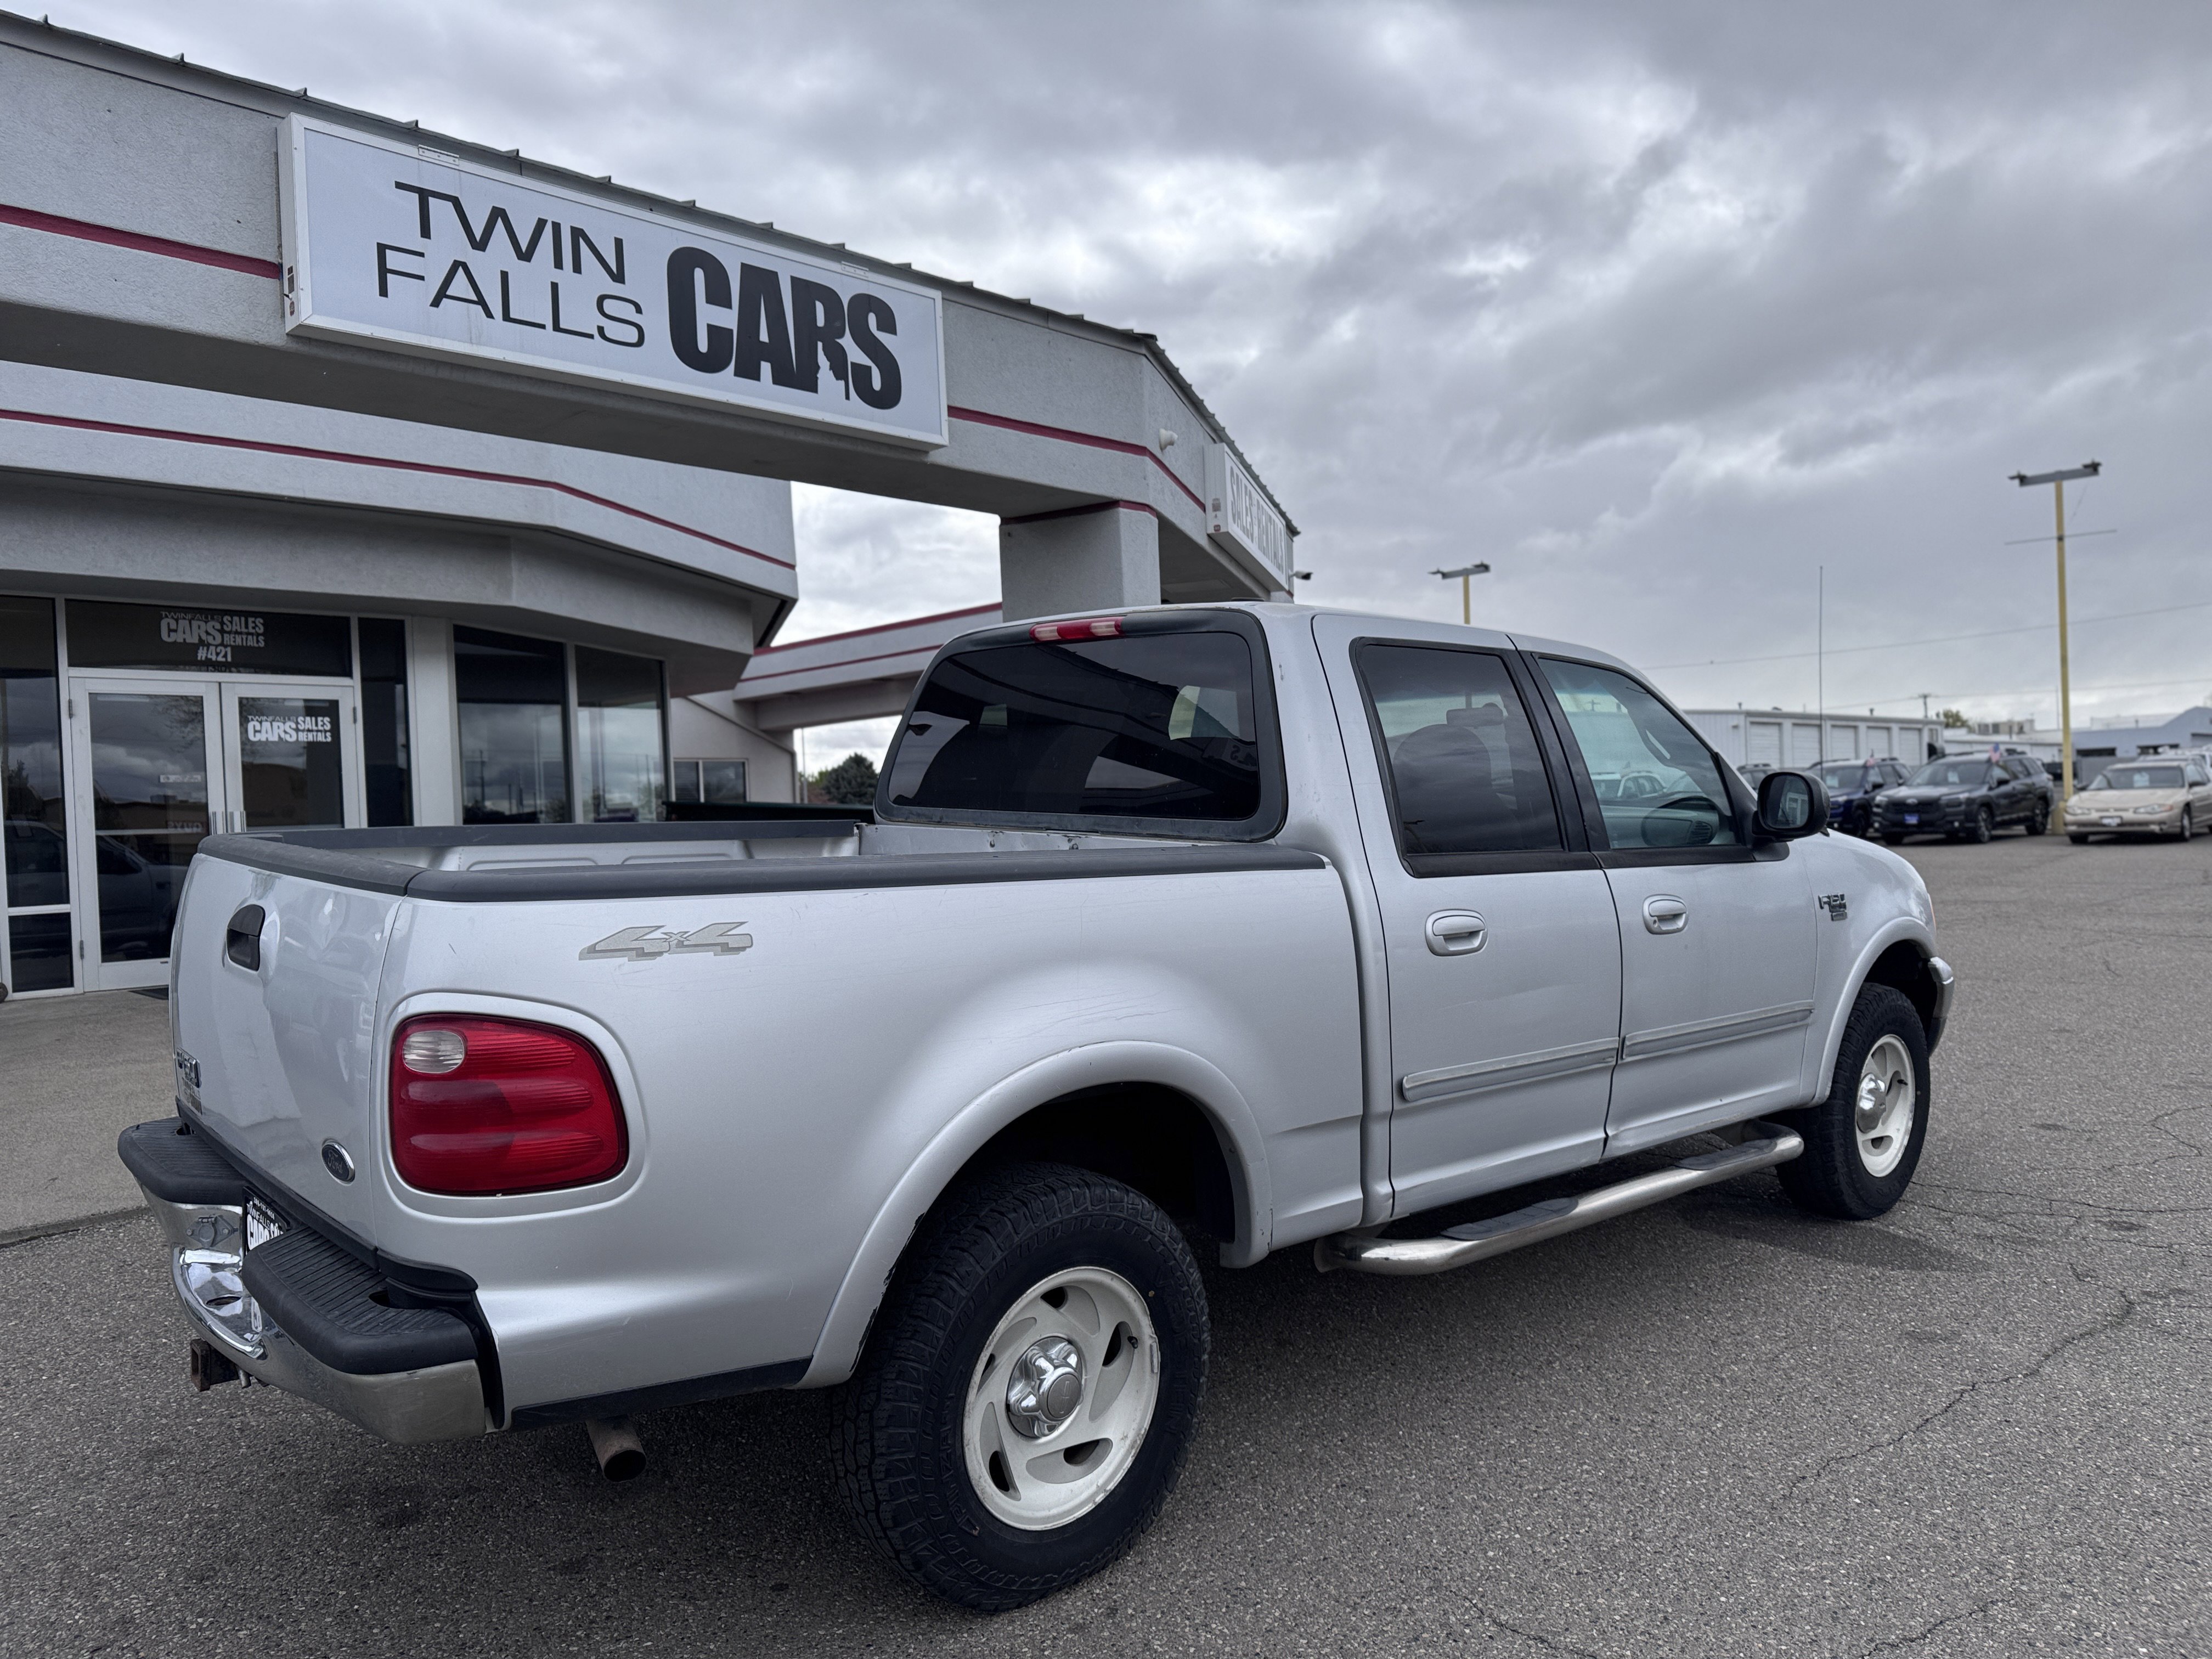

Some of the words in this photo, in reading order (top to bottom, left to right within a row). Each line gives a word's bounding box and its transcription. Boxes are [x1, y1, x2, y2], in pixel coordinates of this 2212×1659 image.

[394, 181, 625, 285] TWIN
[377, 242, 645, 348] FALLS
[667, 246, 902, 410] CARS
[1230, 466, 1254, 544] SALES
[1256, 499, 1284, 575] RENTALS
[160, 618, 222, 645] CARS
[223, 615, 264, 634] SALES
[224, 634, 265, 647] RENTALS
[197, 646, 232, 662] #421
[247, 721, 297, 742] CARS
[297, 716, 331, 731] SALES
[298, 731, 331, 742] RENTALS
[328, 1150, 343, 1173] Ford
